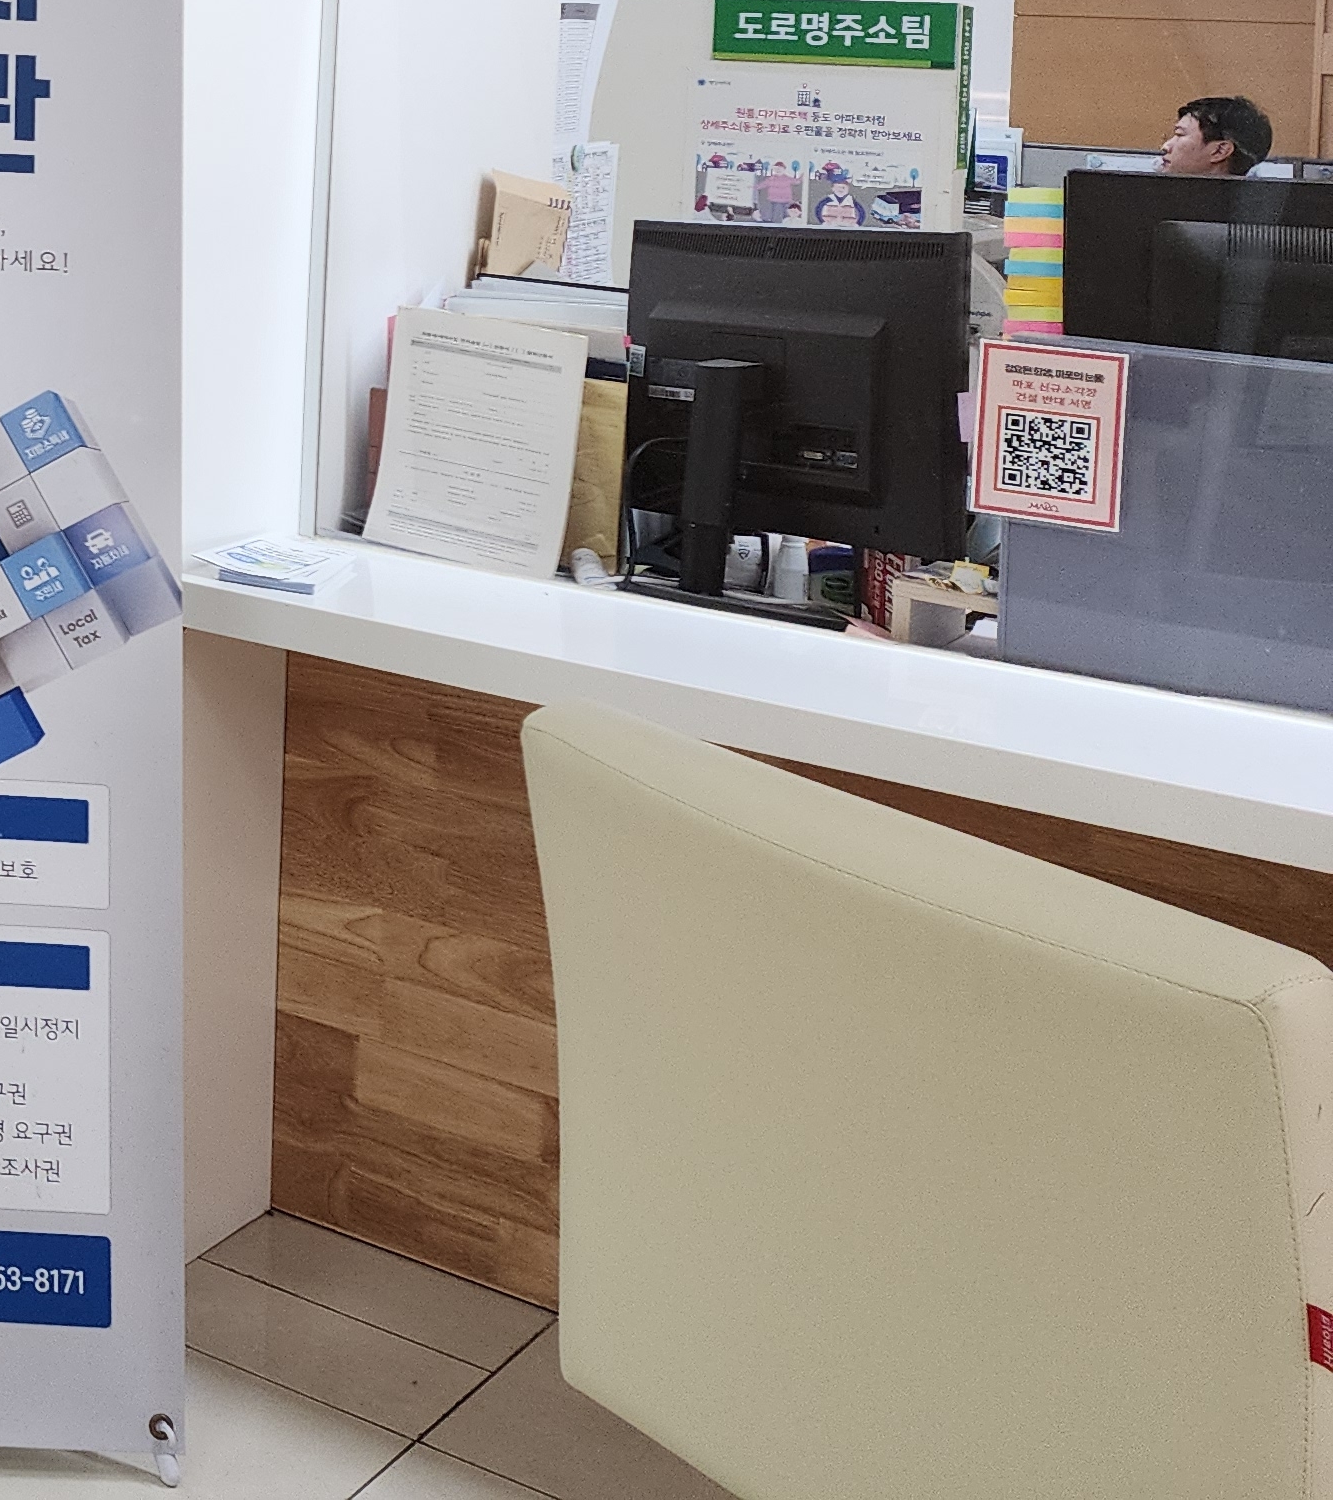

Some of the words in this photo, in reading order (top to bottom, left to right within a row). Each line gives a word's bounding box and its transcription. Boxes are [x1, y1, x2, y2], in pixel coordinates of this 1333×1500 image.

[733, 11, 932, 51] 도로명주소팀
[834, 113, 886, 127] 아파트처럼
[58, 609, 99, 638] Local
[71, 629, 102, 648] Tax
[0, 1015, 81, 1041] 일시정지
[13, 1121, 73, 1148] 요구권
